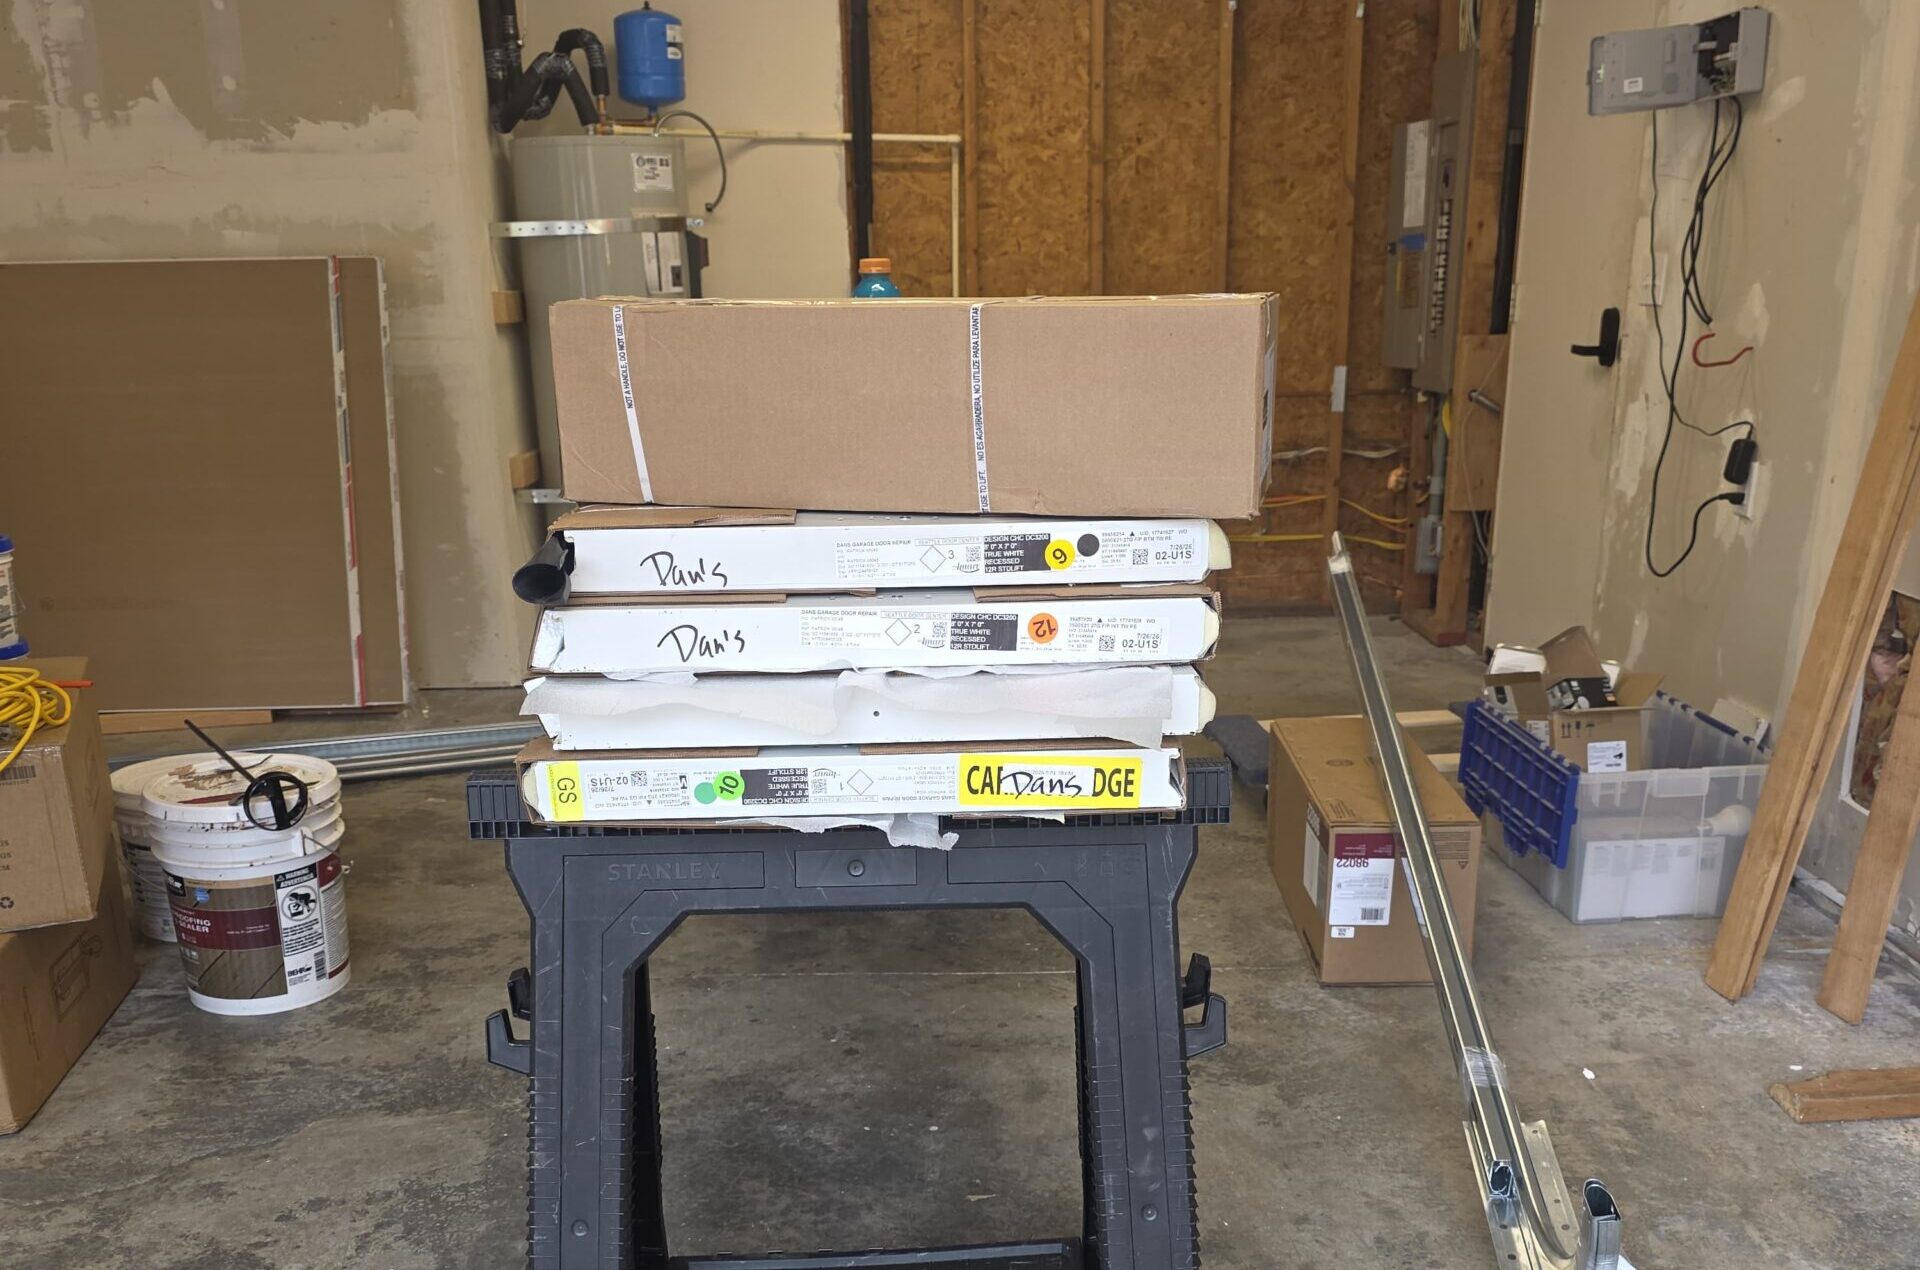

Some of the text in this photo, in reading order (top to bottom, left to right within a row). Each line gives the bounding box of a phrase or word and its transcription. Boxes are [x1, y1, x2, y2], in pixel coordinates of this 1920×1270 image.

[615, 314, 621, 322] TO
[619, 352, 626, 361] DO
[974, 384, 980, 394] NO
[625, 397, 633, 408] NOT
[977, 452, 984, 461] NO
[948, 550, 954, 559] 3
[1155, 551, 1192, 560] 02-U1S
[640, 551, 727, 588] Dan's
[914, 624, 920, 633] 2
[1033, 619, 1056, 638] 12
[657, 625, 745, 662] Dan's
[1122, 640, 1158, 648] 02-U1S
[591, 776, 628, 786] 02-U1S
[719, 776, 739, 794] 10
[1000, 771, 1082, 799] Dans
[557, 778, 577, 803] GS
[1336, 858, 1369, 868] 98022
[608, 862, 720, 880] STANLEY
